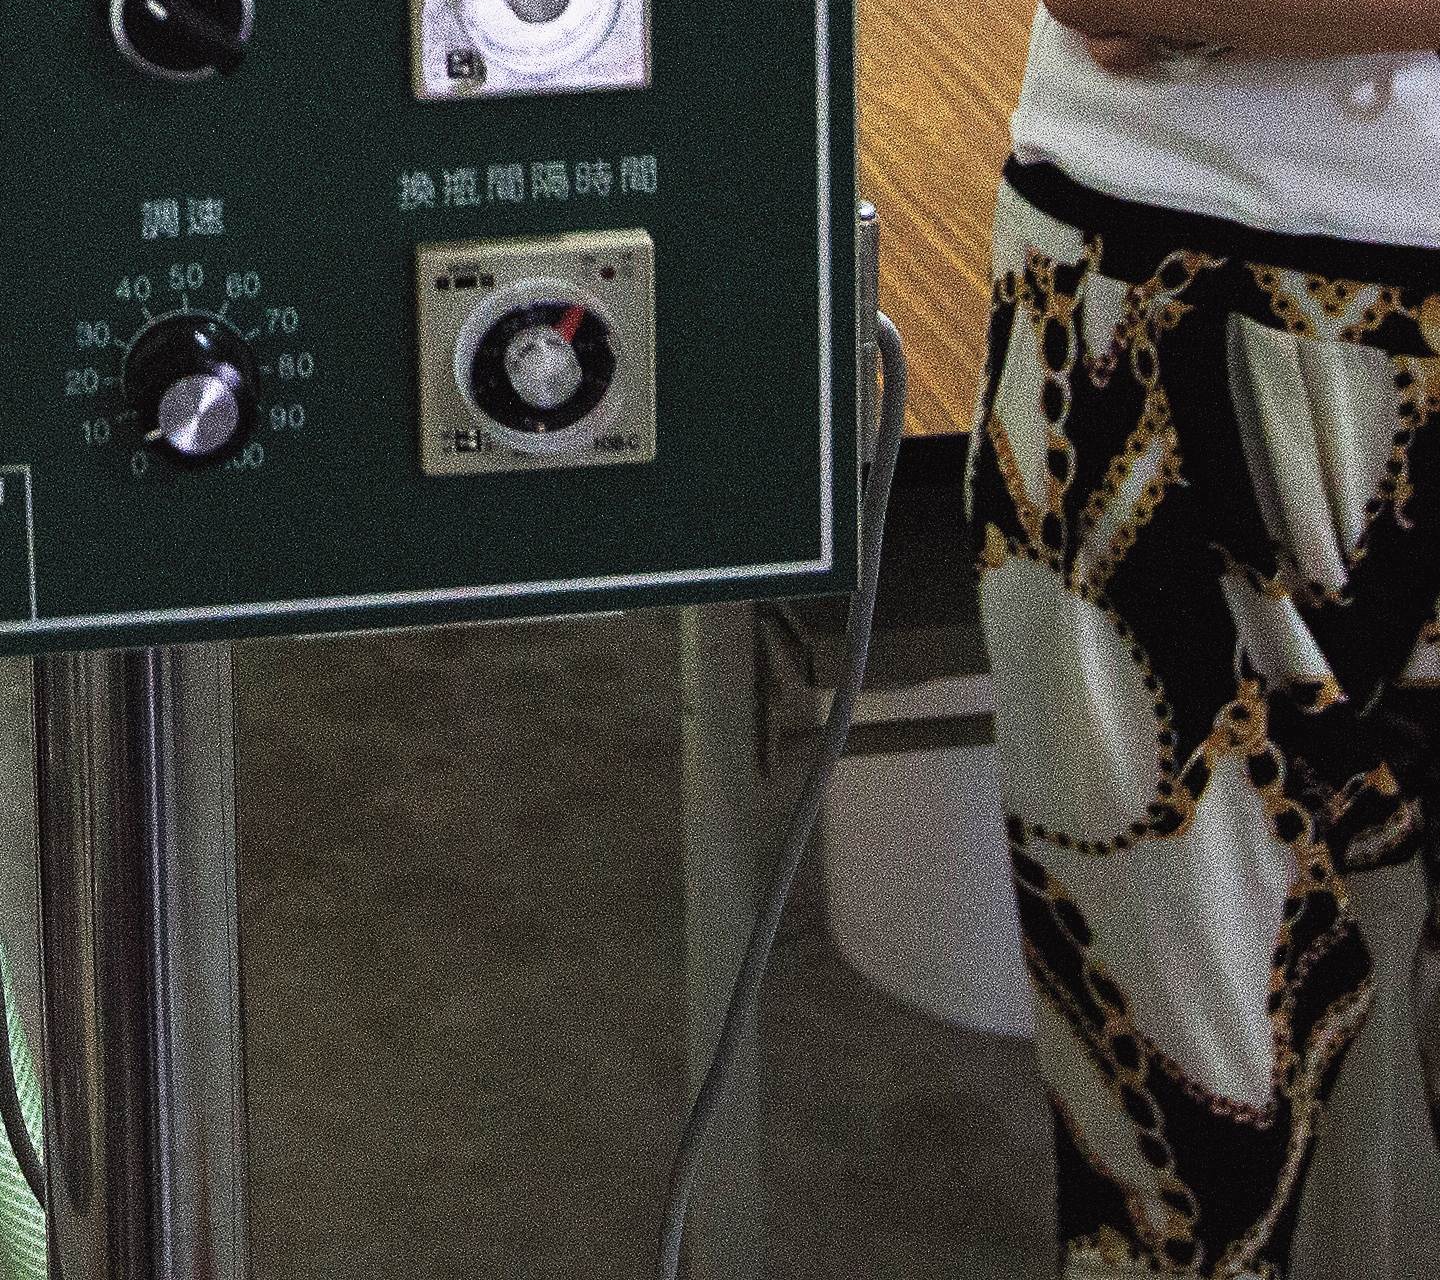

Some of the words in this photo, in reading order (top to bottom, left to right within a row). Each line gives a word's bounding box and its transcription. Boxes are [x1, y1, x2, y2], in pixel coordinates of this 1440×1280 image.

[115, 275, 152, 301] 40
[169, 262, 205, 290] 50
[225, 272, 261, 299] 60
[266, 306, 299, 333] 70
[77, 322, 110, 347] 30
[278, 352, 315, 378] 80
[65, 367, 100, 396] 20
[269, 404, 306, 431] 90
[81, 420, 110, 444] 10
[130, 451, 149, 478] 0
